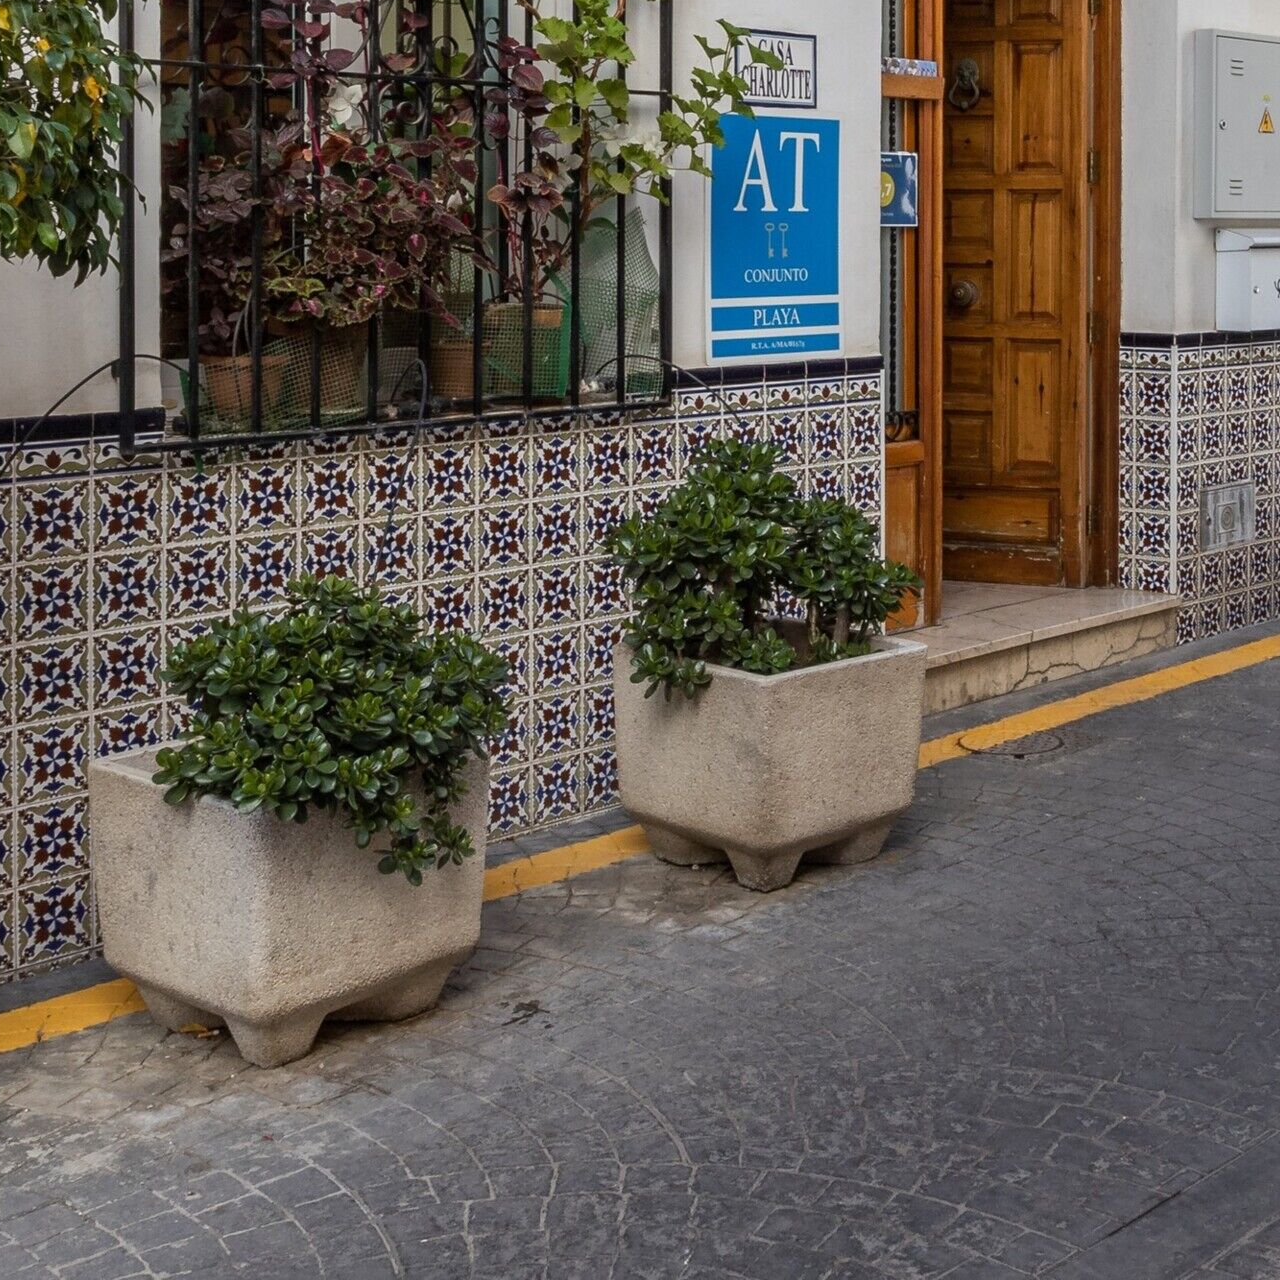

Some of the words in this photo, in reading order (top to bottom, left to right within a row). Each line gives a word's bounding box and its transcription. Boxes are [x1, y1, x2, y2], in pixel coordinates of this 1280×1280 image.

[741, 65, 812, 100] CHARLOTTE
[733, 129, 821, 212] AT
[744, 268, 809, 284] CONJUNTO
[753, 308, 801, 327] PLAYA
